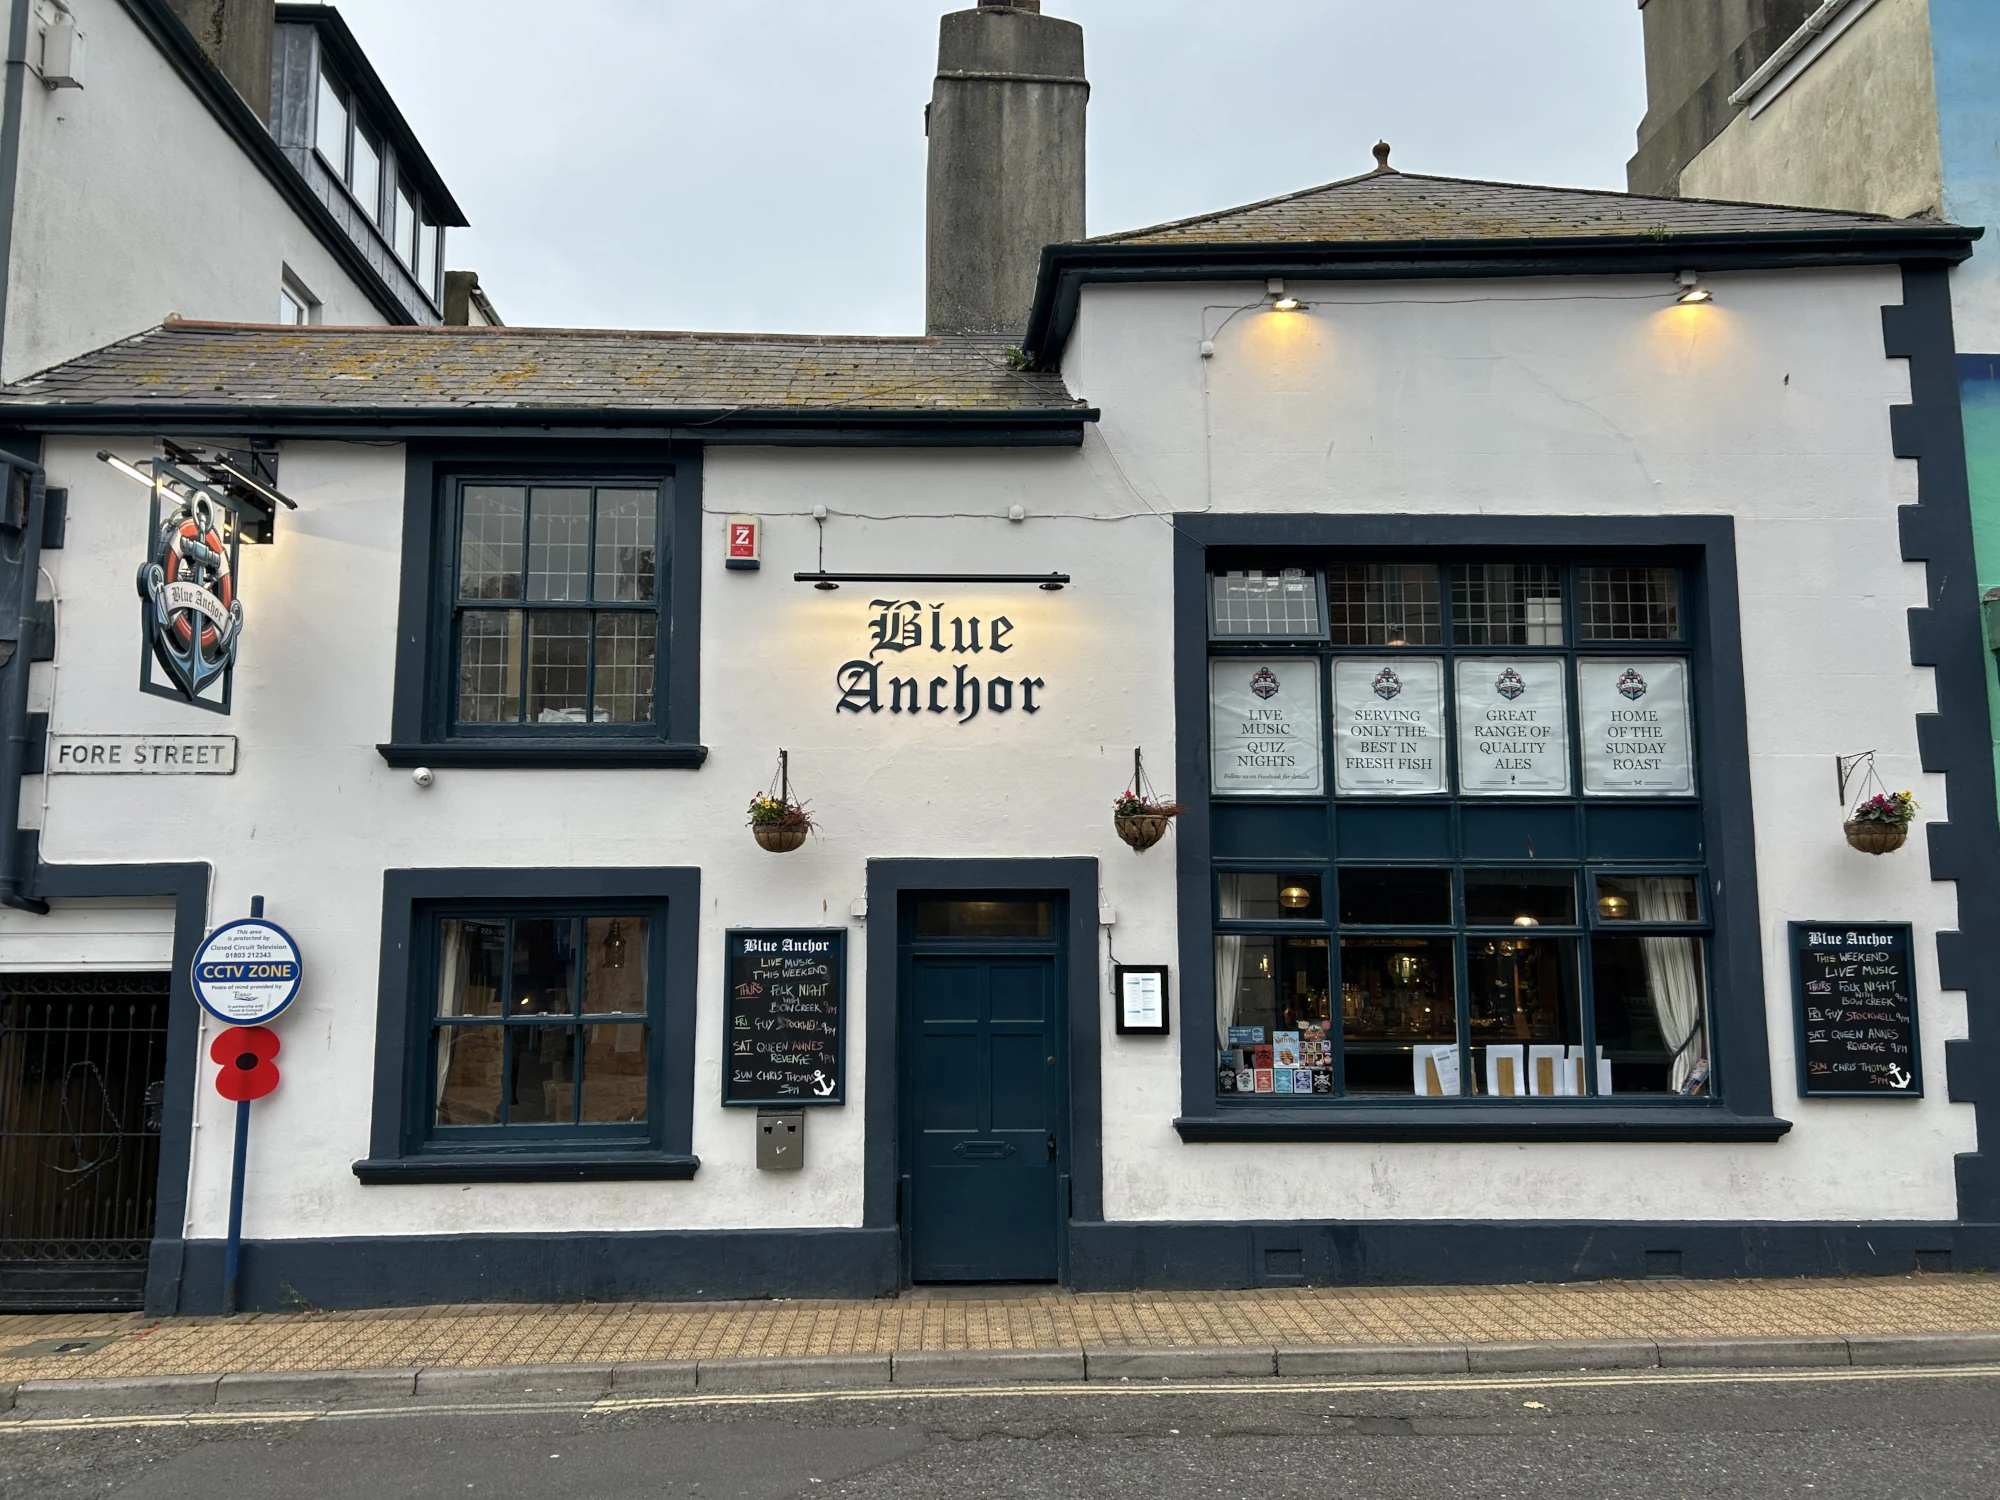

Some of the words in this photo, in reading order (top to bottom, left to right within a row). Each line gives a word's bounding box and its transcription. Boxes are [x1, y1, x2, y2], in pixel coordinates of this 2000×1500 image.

[736, 530, 749, 544] Z
[171, 586, 193, 605] Blue
[195, 590, 223, 620] Anchor
[868, 599, 1014, 659] Blue
[836, 660, 1044, 724] Anchor
[1248, 710, 1282, 720] LIVE
[1354, 710, 1421, 721] SERVING
[1486, 710, 1536, 721] GREAT
[1610, 710, 1658, 721] HOME
[1241, 724, 1290, 734] MUSIC
[1350, 725, 1392, 737] ONLY
[1394, 726, 1426, 737] THE
[1474, 726, 1526, 737] RANGE
[1530, 726, 1551, 737] OF
[1608, 726, 1628, 737] OF
[1630, 726, 1662, 737] THE
[1247, 742, 1285, 754] QUIZ
[1360, 742, 1396, 753] BEST
[1400, 742, 1417, 753] IN
[1479, 742, 1546, 754] QUALITY
[1605, 743, 1666, 754] SUNDAY
[58, 745, 122, 764] FORE
[134, 745, 226, 764] STREET
[1237, 756, 1295, 767] NIGHTS
[1345, 758, 1393, 768] FRESH
[1398, 758, 1432, 770] FISH
[1494, 758, 1531, 769] ALES
[1612, 759, 1661, 770] ROAST
[744, 938, 777, 953] Blue
[782, 938, 829, 953] Anchor
[1808, 932, 1842, 946] Blue
[1846, 932, 1893, 947] Anchor
[761, 957, 783, 968] LIVE
[784, 958, 815, 968] MUSIC
[1814, 953, 1836, 963] THIS
[1839, 952, 1889, 962] WEEKEND
[203, 965, 244, 978] CCTV
[248, 965, 291, 977] ZONE
[753, 970, 779, 980] THIS
[782, 965, 827, 978] WEEKEND
[1826, 965, 1858, 978] LIVE
[1862, 966, 1899, 975] MUSIC
[735, 982, 763, 996] THURS
[770, 984, 794, 998] FOLK
[799, 983, 829, 997] NIGHT
[1806, 980, 1831, 991] THURS
[1838, 981, 1860, 992] FOLK
[1863, 980, 1896, 992] NIGHT
[1865, 998, 1896, 1007] CREEK
[1808, 1008, 1821, 1019] FRI
[1825, 1009, 1843, 1022] GUY
[1845, 1012, 1896, 1021] STOCKWELL
[1896, 1013, 1910, 1024] 9PM
[735, 1015, 748, 1026] FRI
[754, 1018, 775, 1030] GUY
[821, 1022, 836, 1036] 9PM
[1807, 1030, 1826, 1039] SAT
[1831, 1030, 1863, 1040] QUEEN
[1868, 1028, 1899, 1040] ANNES
[733, 1039, 752, 1051] SAT
[757, 1042, 788, 1053] QUEEN
[792, 1041, 824, 1052] ANNES
[1846, 1042, 1885, 1053] REVENGE
[1891, 1043, 1907, 1054] 9PM
[770, 1053, 813, 1065] REVENGE
[1809, 1061, 1827, 1071] SUN
[1832, 1063, 1856, 1071] CHRIS
[733, 1070, 752, 1080] SUN
[756, 1070, 782, 1080] CHRIS
